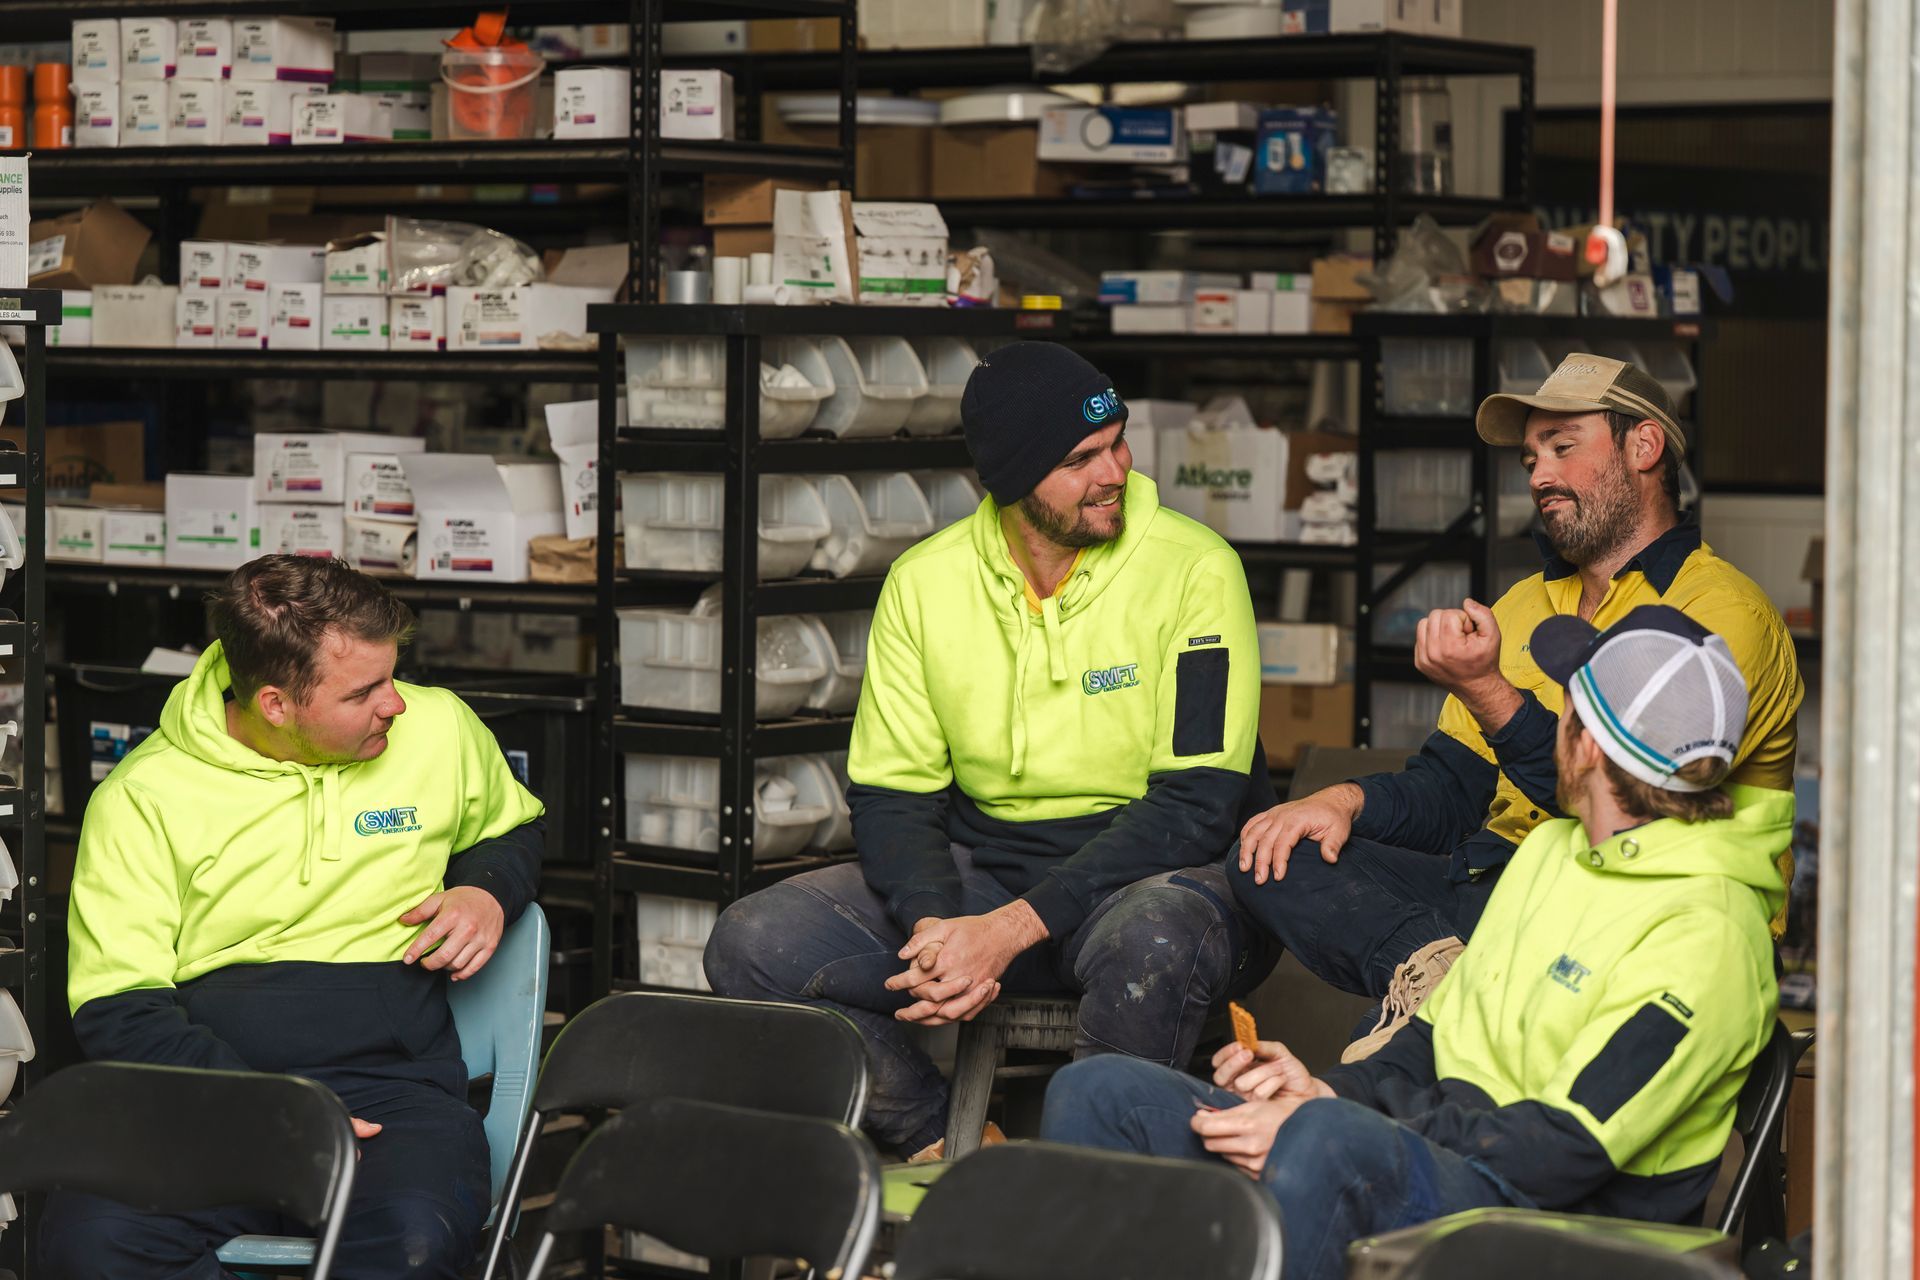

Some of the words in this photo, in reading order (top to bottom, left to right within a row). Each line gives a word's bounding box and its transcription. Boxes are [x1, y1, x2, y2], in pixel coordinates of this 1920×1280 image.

[1702, 213, 1829, 272] PEOPL
[1174, 462, 1252, 488] Atkore
[1088, 663, 1138, 689] SWIFT
[364, 806, 417, 829] SWIFT
[382, 827, 404, 835] ENERGY
